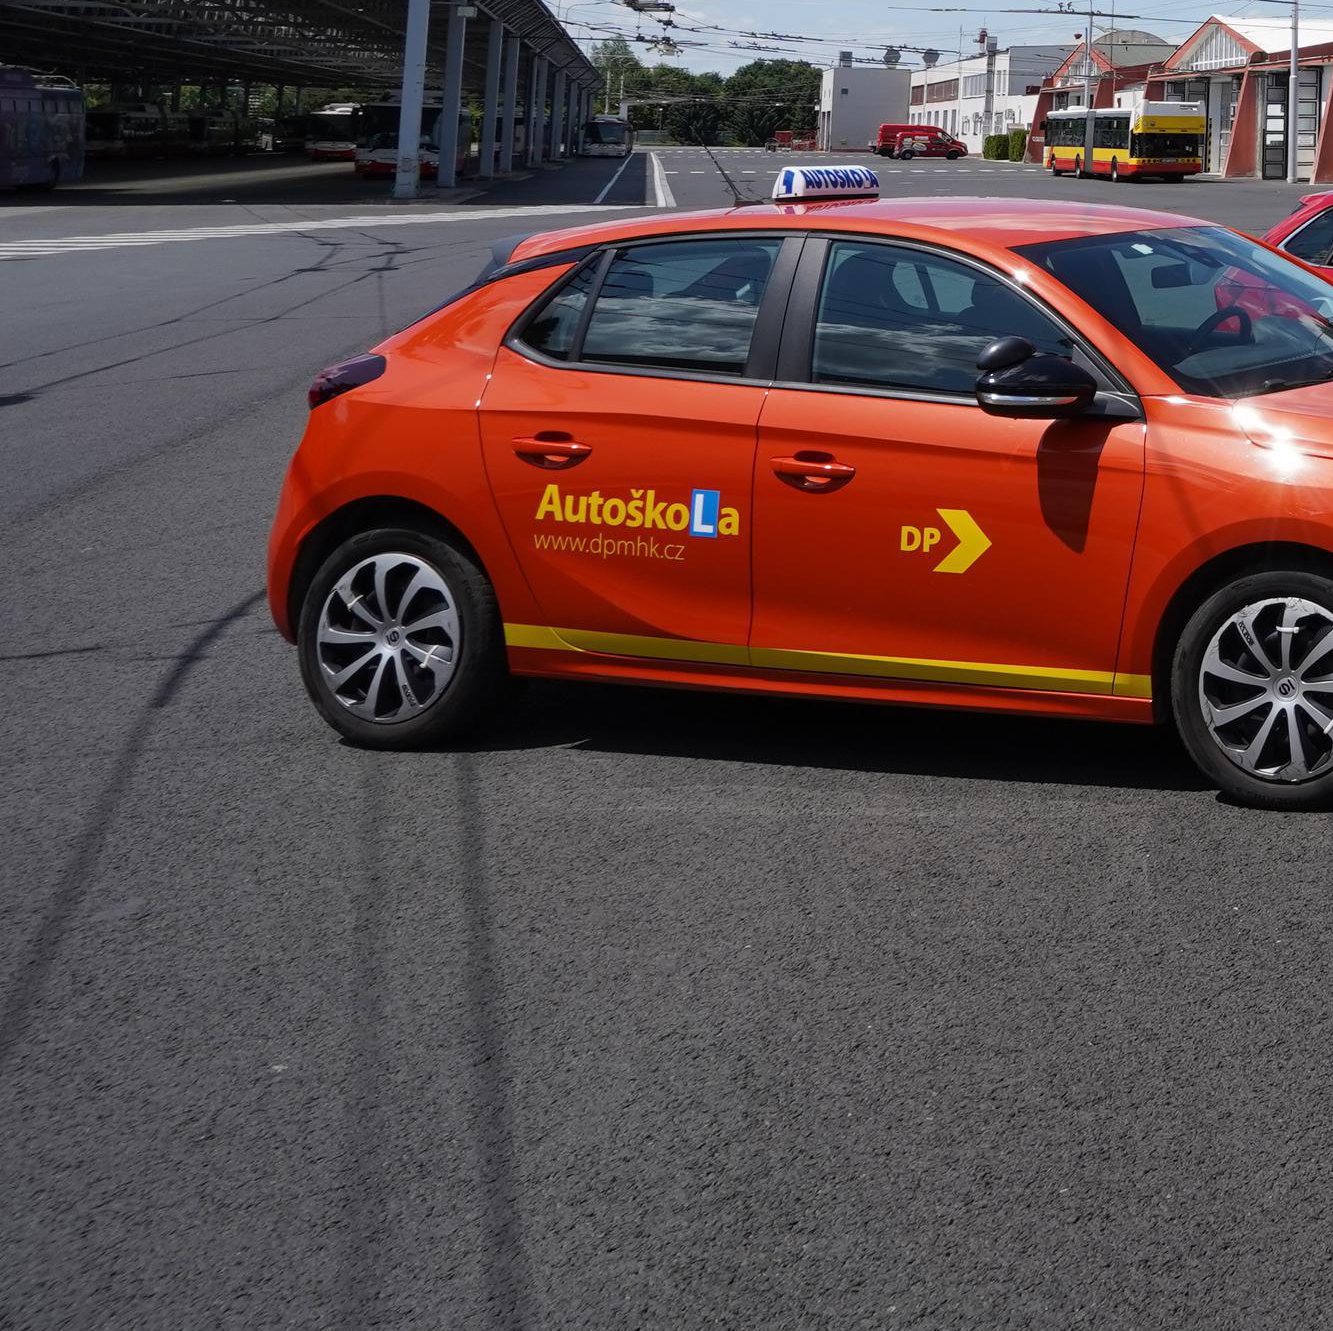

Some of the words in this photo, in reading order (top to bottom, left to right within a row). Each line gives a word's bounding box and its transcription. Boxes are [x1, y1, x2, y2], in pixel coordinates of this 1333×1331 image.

[534, 483, 741, 538] AutoškoLa
[533, 533, 686, 561] www.dpmhk.cz
[900, 525, 942, 553] DP
